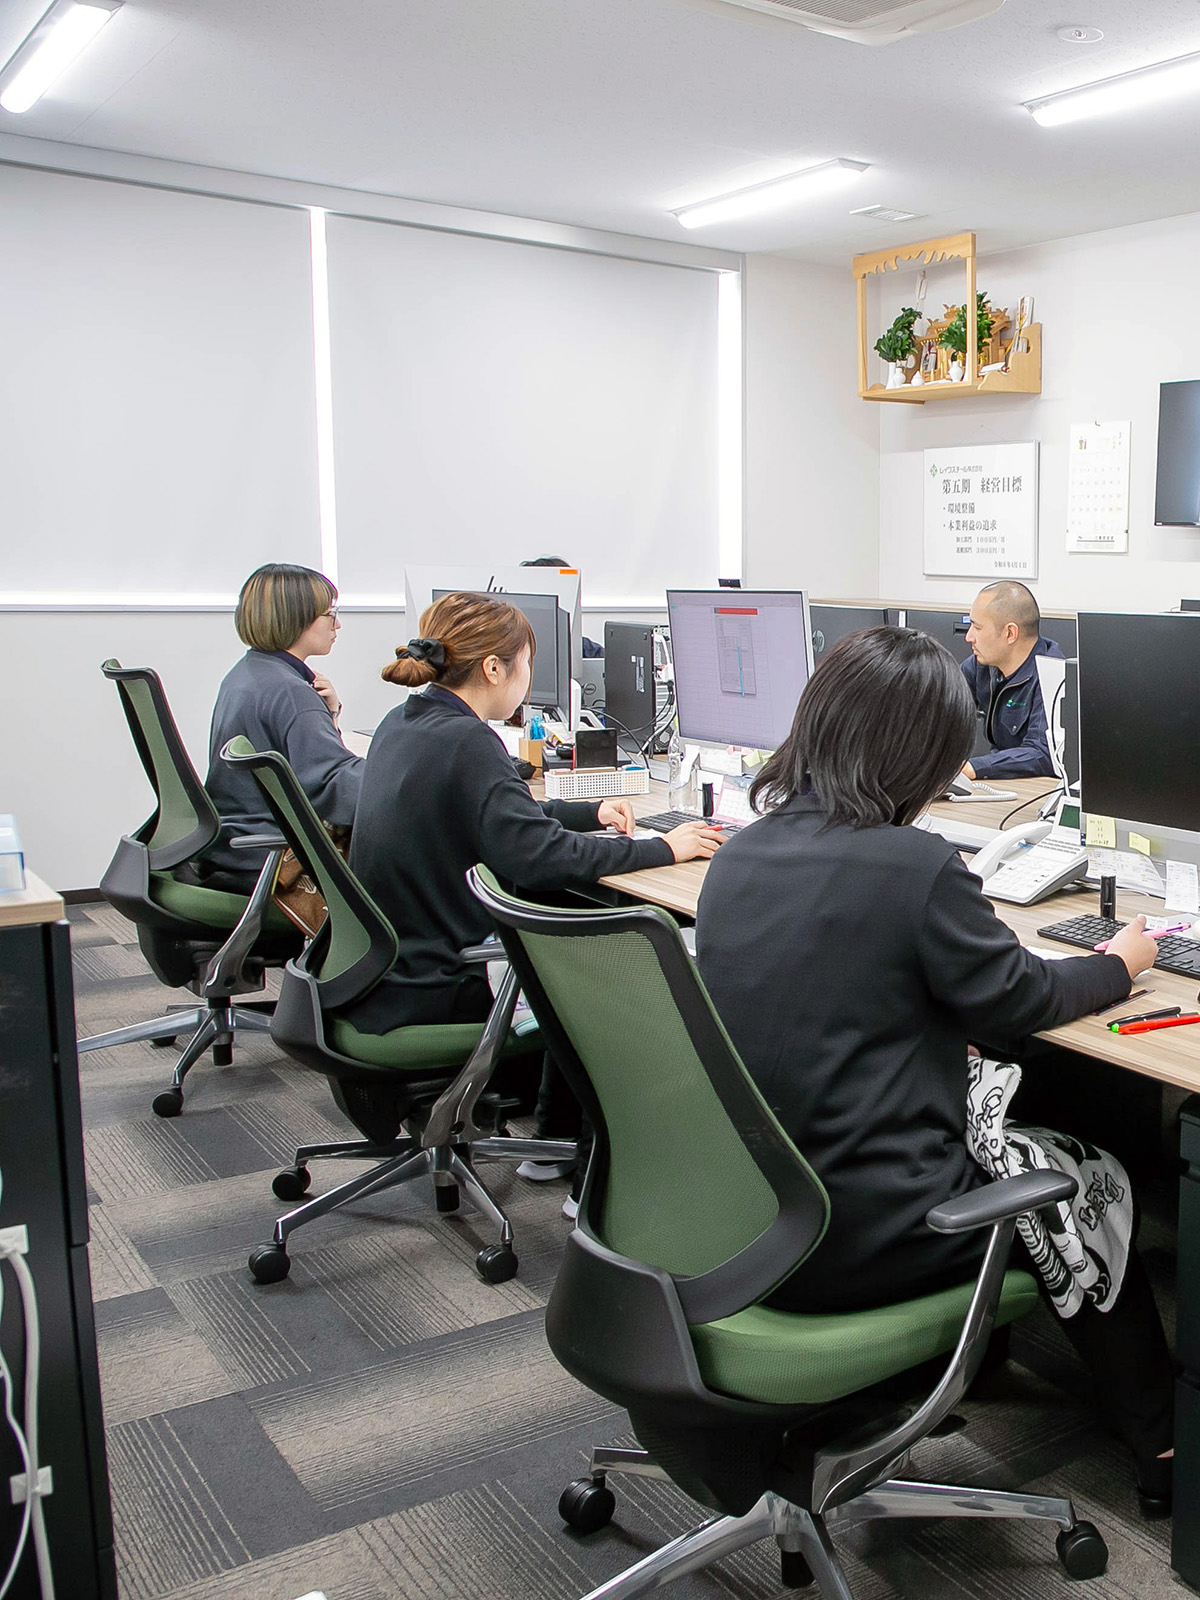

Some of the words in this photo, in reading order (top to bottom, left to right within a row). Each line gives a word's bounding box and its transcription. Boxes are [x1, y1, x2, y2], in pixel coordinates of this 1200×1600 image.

[942, 478, 971, 494] 第五期
[980, 475, 1022, 493] 経営目標
